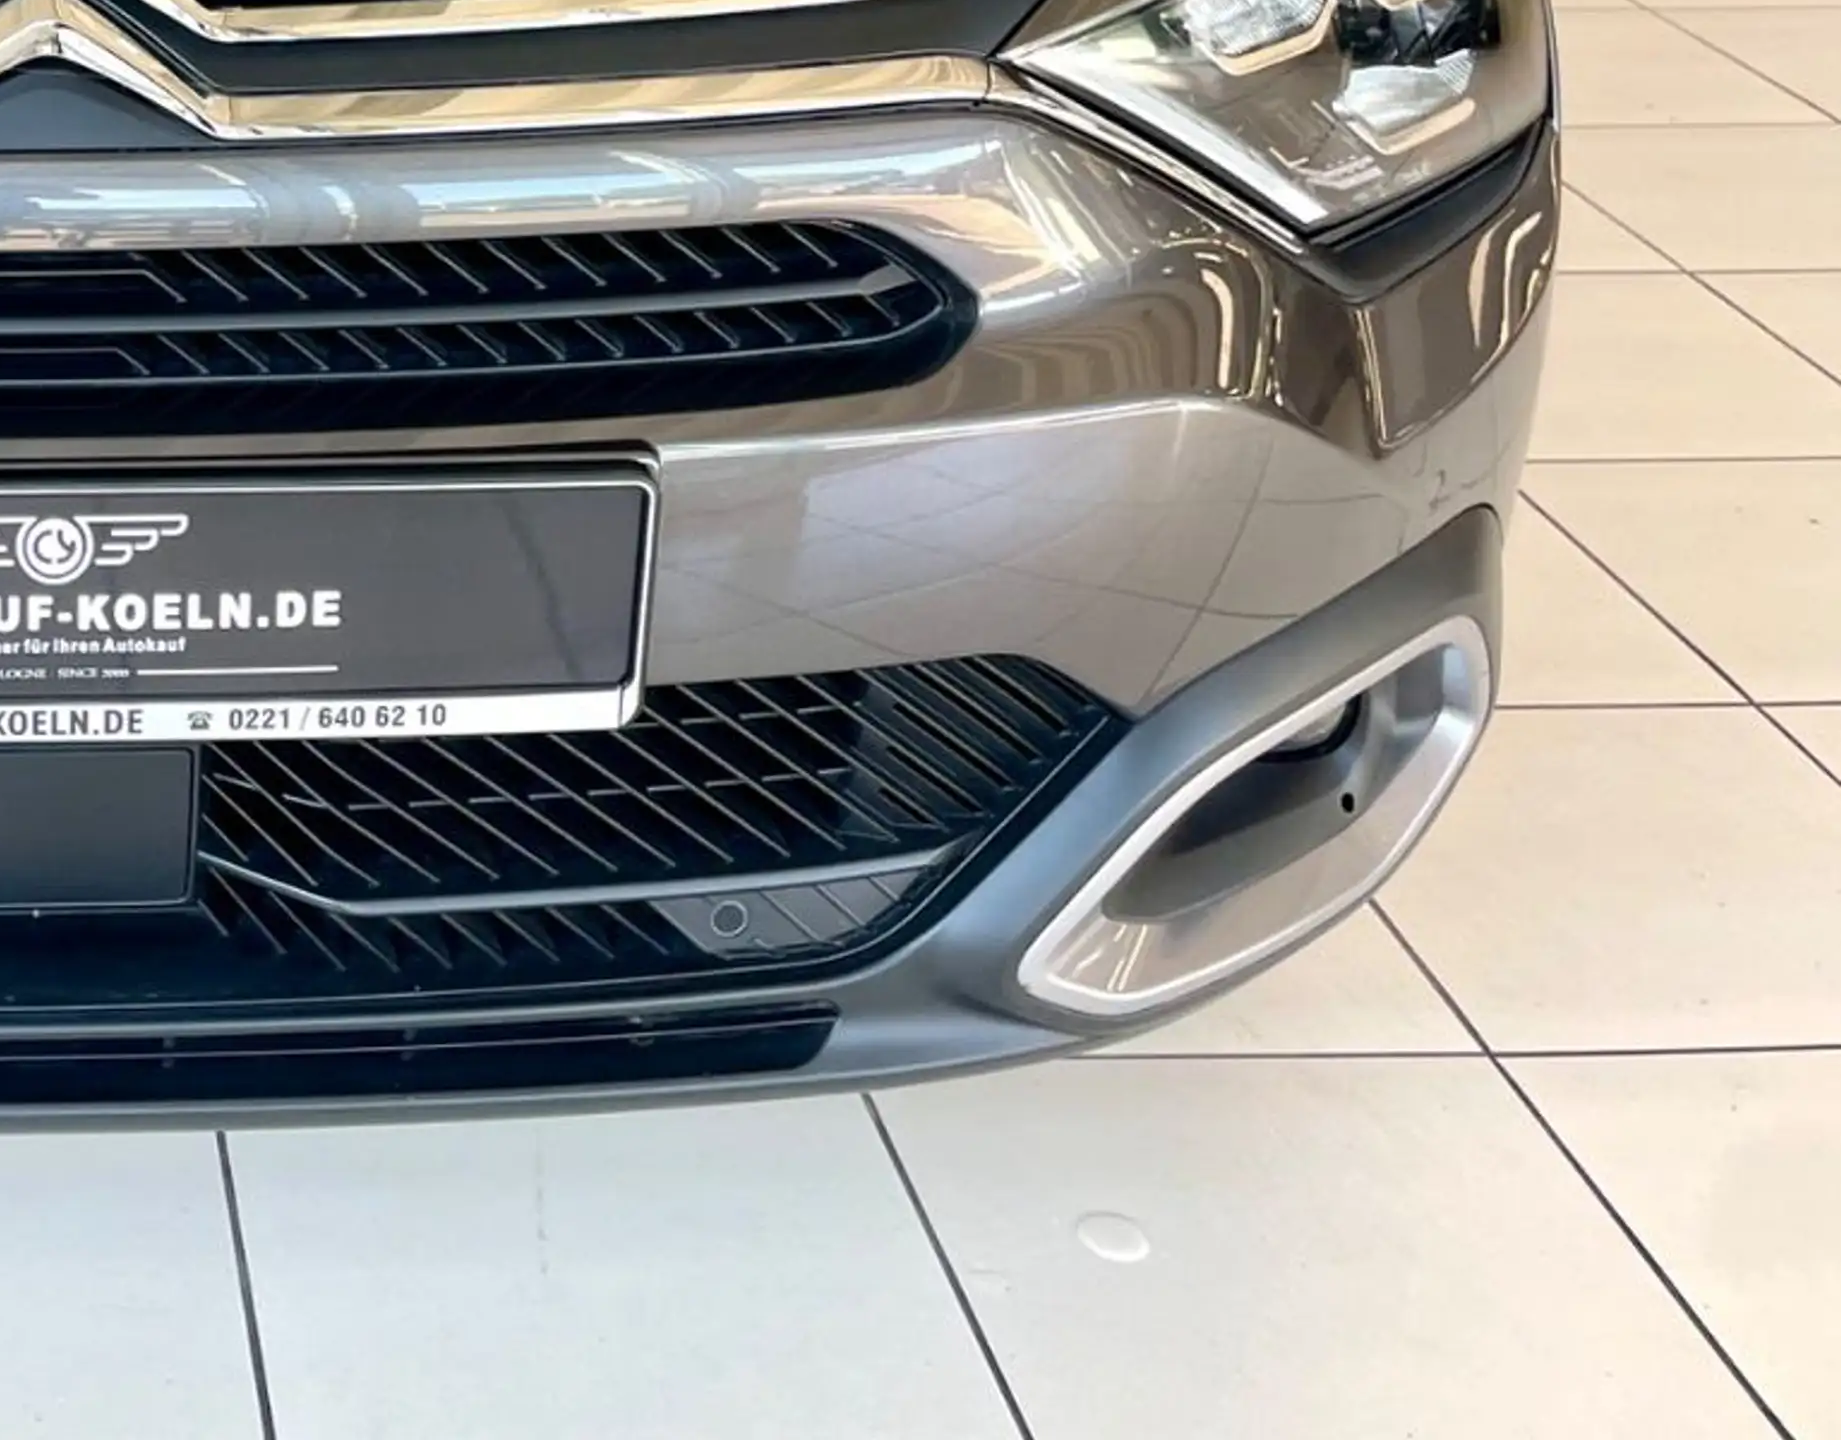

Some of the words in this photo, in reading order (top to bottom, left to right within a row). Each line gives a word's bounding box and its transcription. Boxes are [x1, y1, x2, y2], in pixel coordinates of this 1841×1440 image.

[23, 636, 49, 655] für
[52, 636, 100, 654] Ihren
[102, 635, 187, 653] Autokauf
[228, 709, 291, 731] 0221
[299, 706, 311, 731] /
[318, 705, 365, 729] 640
[375, 704, 407, 728] 62
[417, 703, 447, 727] 10
